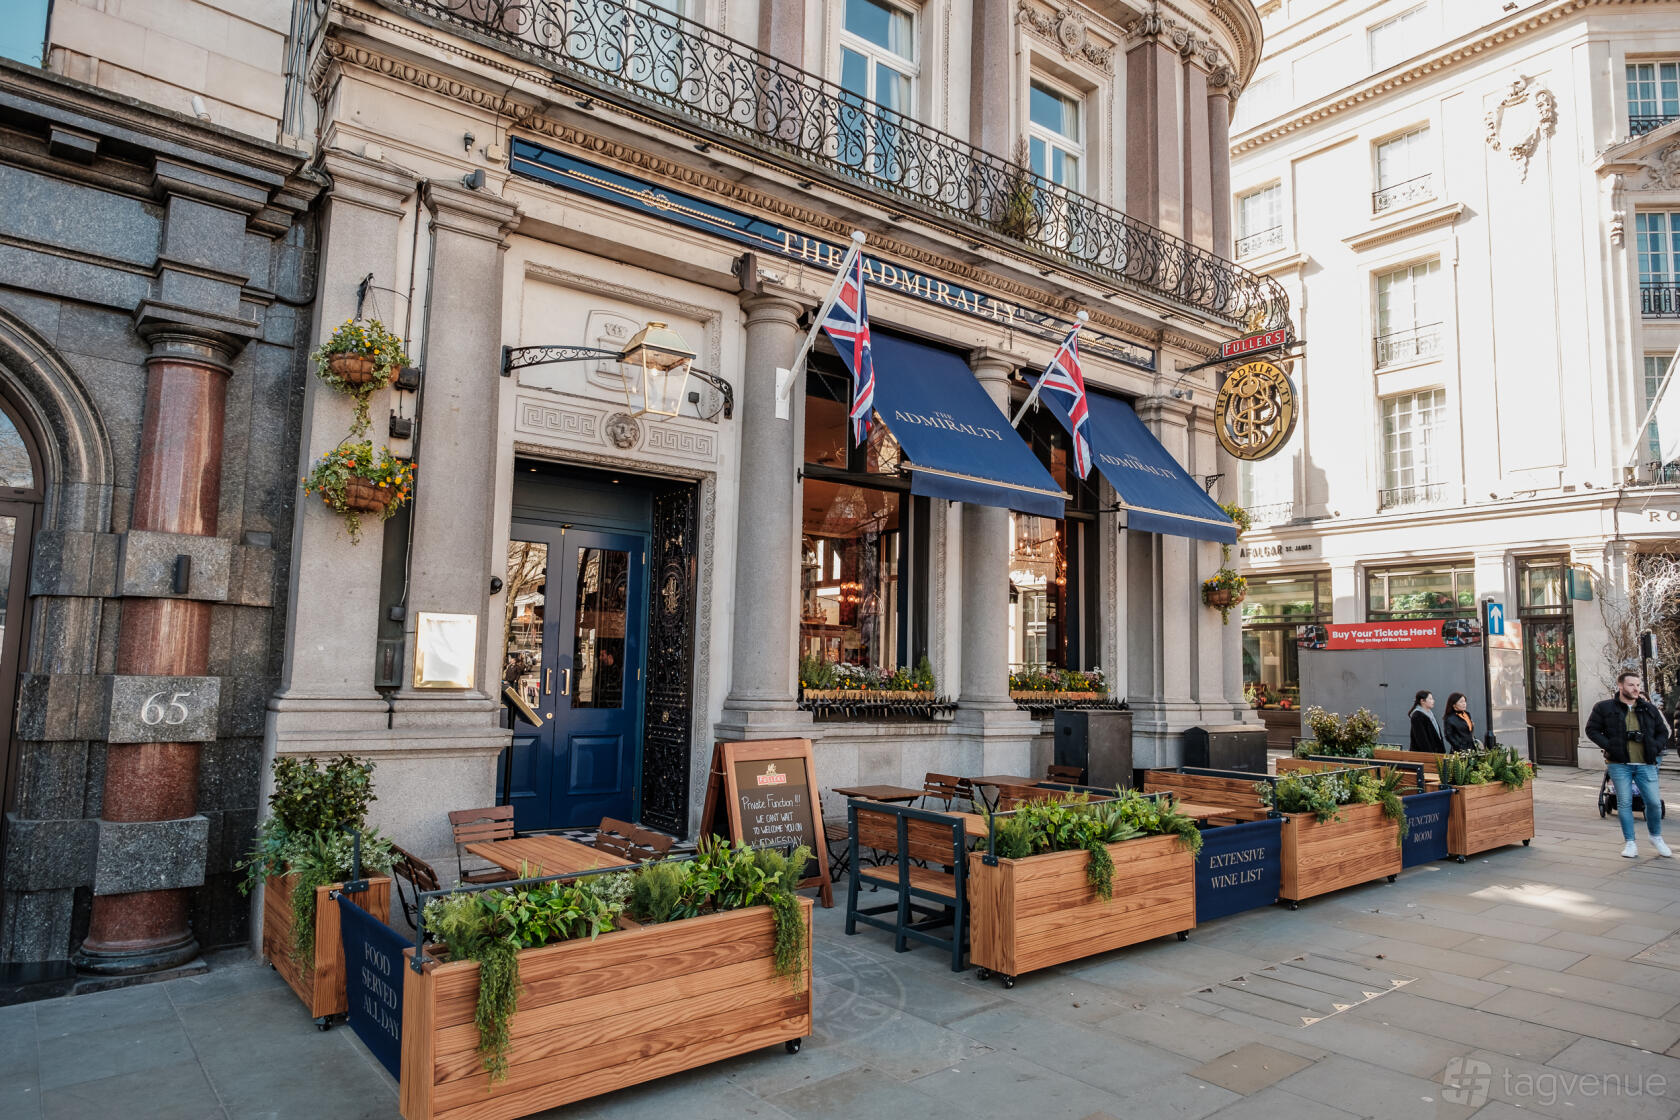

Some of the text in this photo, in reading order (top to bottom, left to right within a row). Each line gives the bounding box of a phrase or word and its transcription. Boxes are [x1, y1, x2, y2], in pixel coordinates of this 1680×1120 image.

[777, 229, 1019, 325] THE ADMIRALTY
[1216, 363, 1291, 420] THE ADMIRALTY
[895, 410, 1003, 441] ADMIRALTY
[933, 410, 954, 420] THE
[1099, 453, 1178, 480] ADMIRALTY
[1295, 544, 1313, 552] JAMES
[1332, 627, 1437, 640] Buy Your Tickets Here!
[141, 691, 191, 725] 65
[741, 795, 767, 811] Private
[766, 793, 794, 808] Function
[753, 822, 803, 835] TO WELCOME YOU ON
[755, 814, 765, 824] WE
[781, 811, 794, 822] WAIT
[1413, 830, 1433, 843] ROOM
[1210, 847, 1266, 869] EXTENSIVE
[1211, 868, 1264, 889] WINE LIST
[364, 941, 391, 976] FOOD
[362, 966, 398, 1010] SERVED
[364, 994, 399, 1040] ALL DAY
